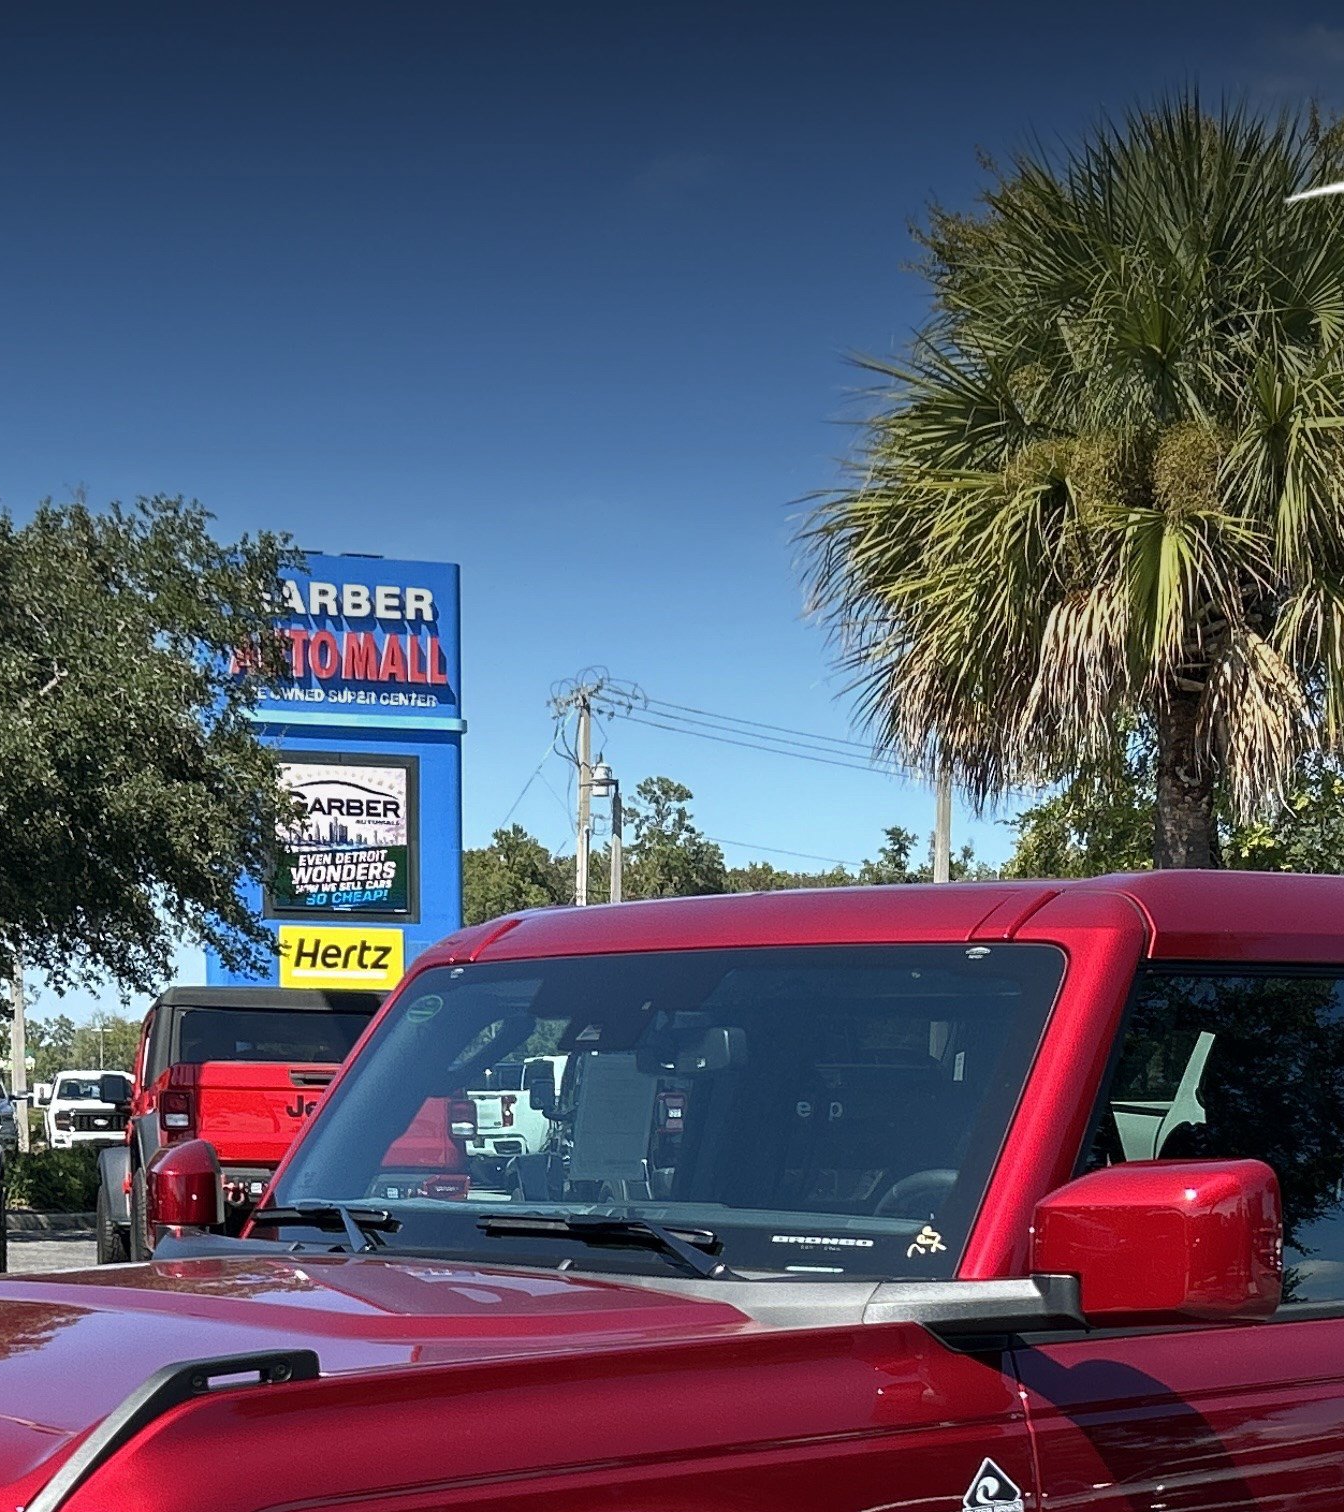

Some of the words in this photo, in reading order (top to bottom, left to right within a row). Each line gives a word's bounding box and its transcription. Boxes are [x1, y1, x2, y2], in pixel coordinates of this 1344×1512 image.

[262, 580, 434, 621] ARBER
[328, 688, 377, 706] SUPER
[379, 691, 438, 708] CENTER
[299, 852, 333, 866] EVEN
[335, 849, 389, 865] DETROIT
[290, 861, 397, 884] WONDERS
[306, 893, 328, 906] SO
[331, 890, 389, 904] CHEAP!
[293, 938, 392, 970] Hertz
